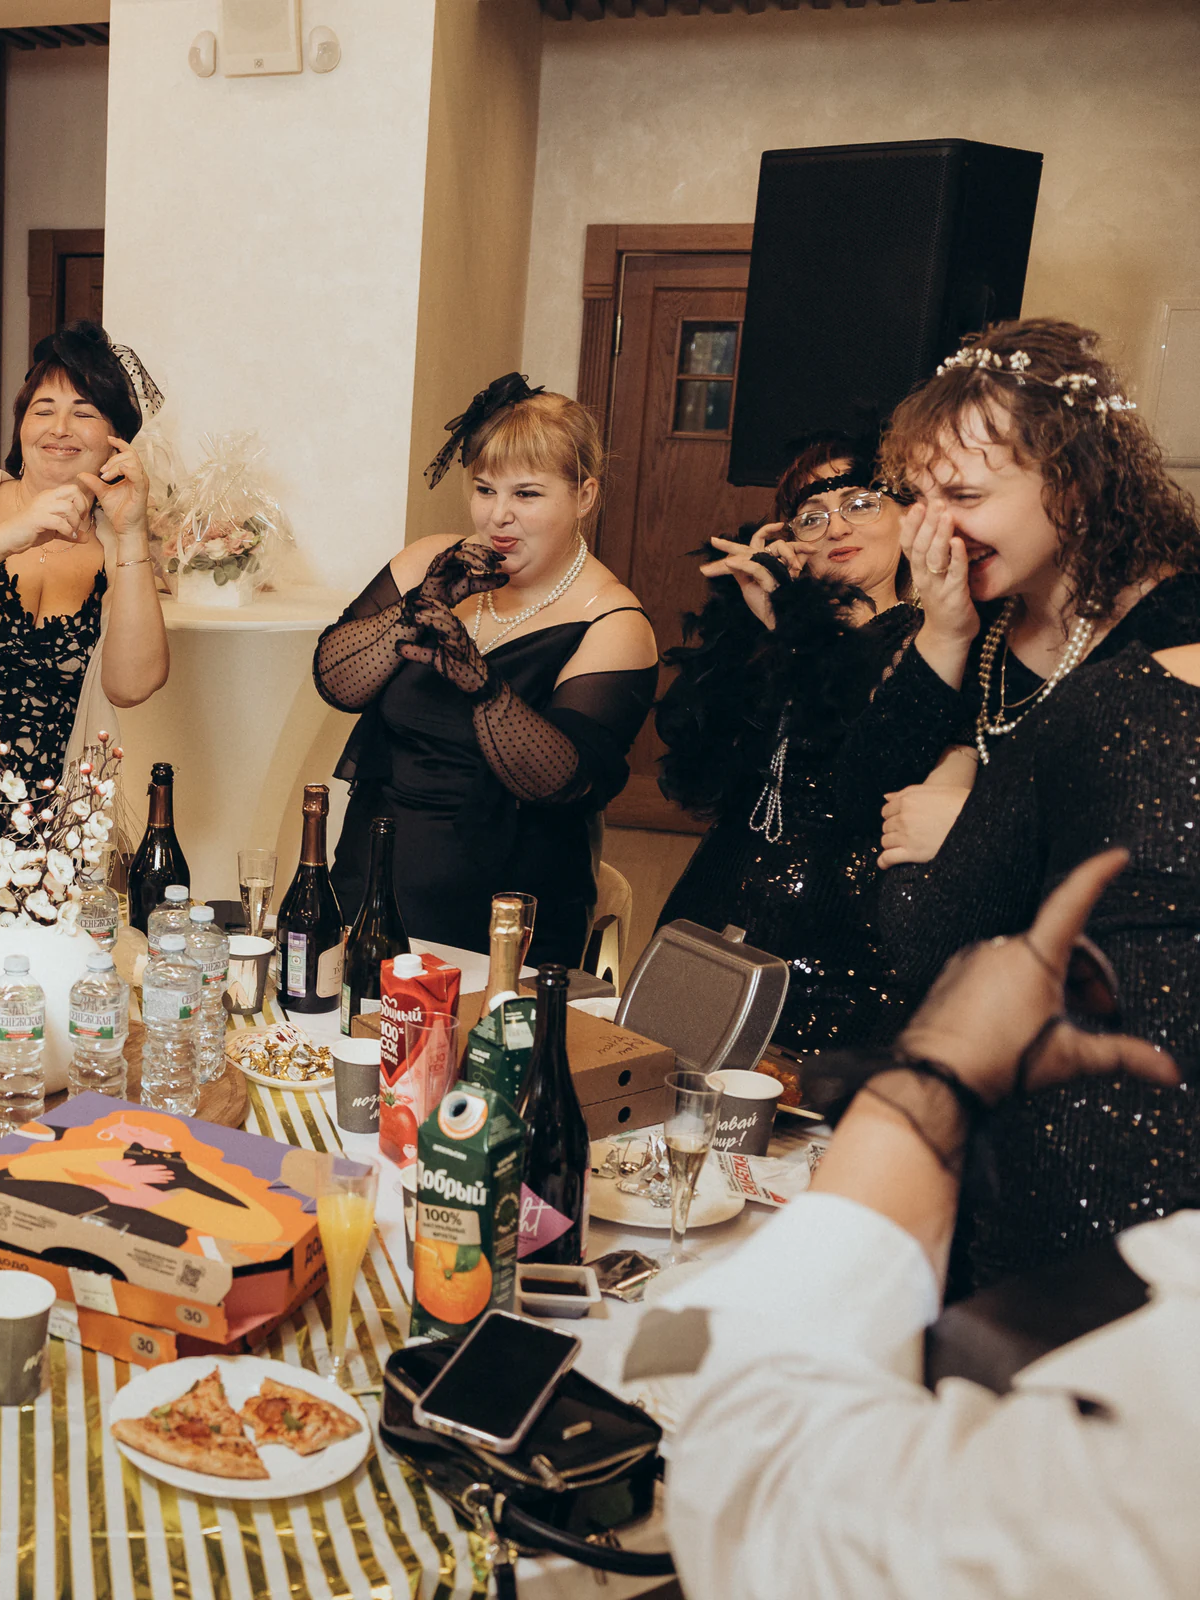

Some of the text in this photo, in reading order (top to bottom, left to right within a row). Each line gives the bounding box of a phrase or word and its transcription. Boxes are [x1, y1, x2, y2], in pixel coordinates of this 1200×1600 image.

[80, 917, 117, 928] СЕНЕЖСКАЯ
[380, 1036, 399, 1057] СОК
[425, 1208, 463, 1226] 100%
[183, 1308, 203, 1323] 30
[137, 1337, 154, 1354] 30
